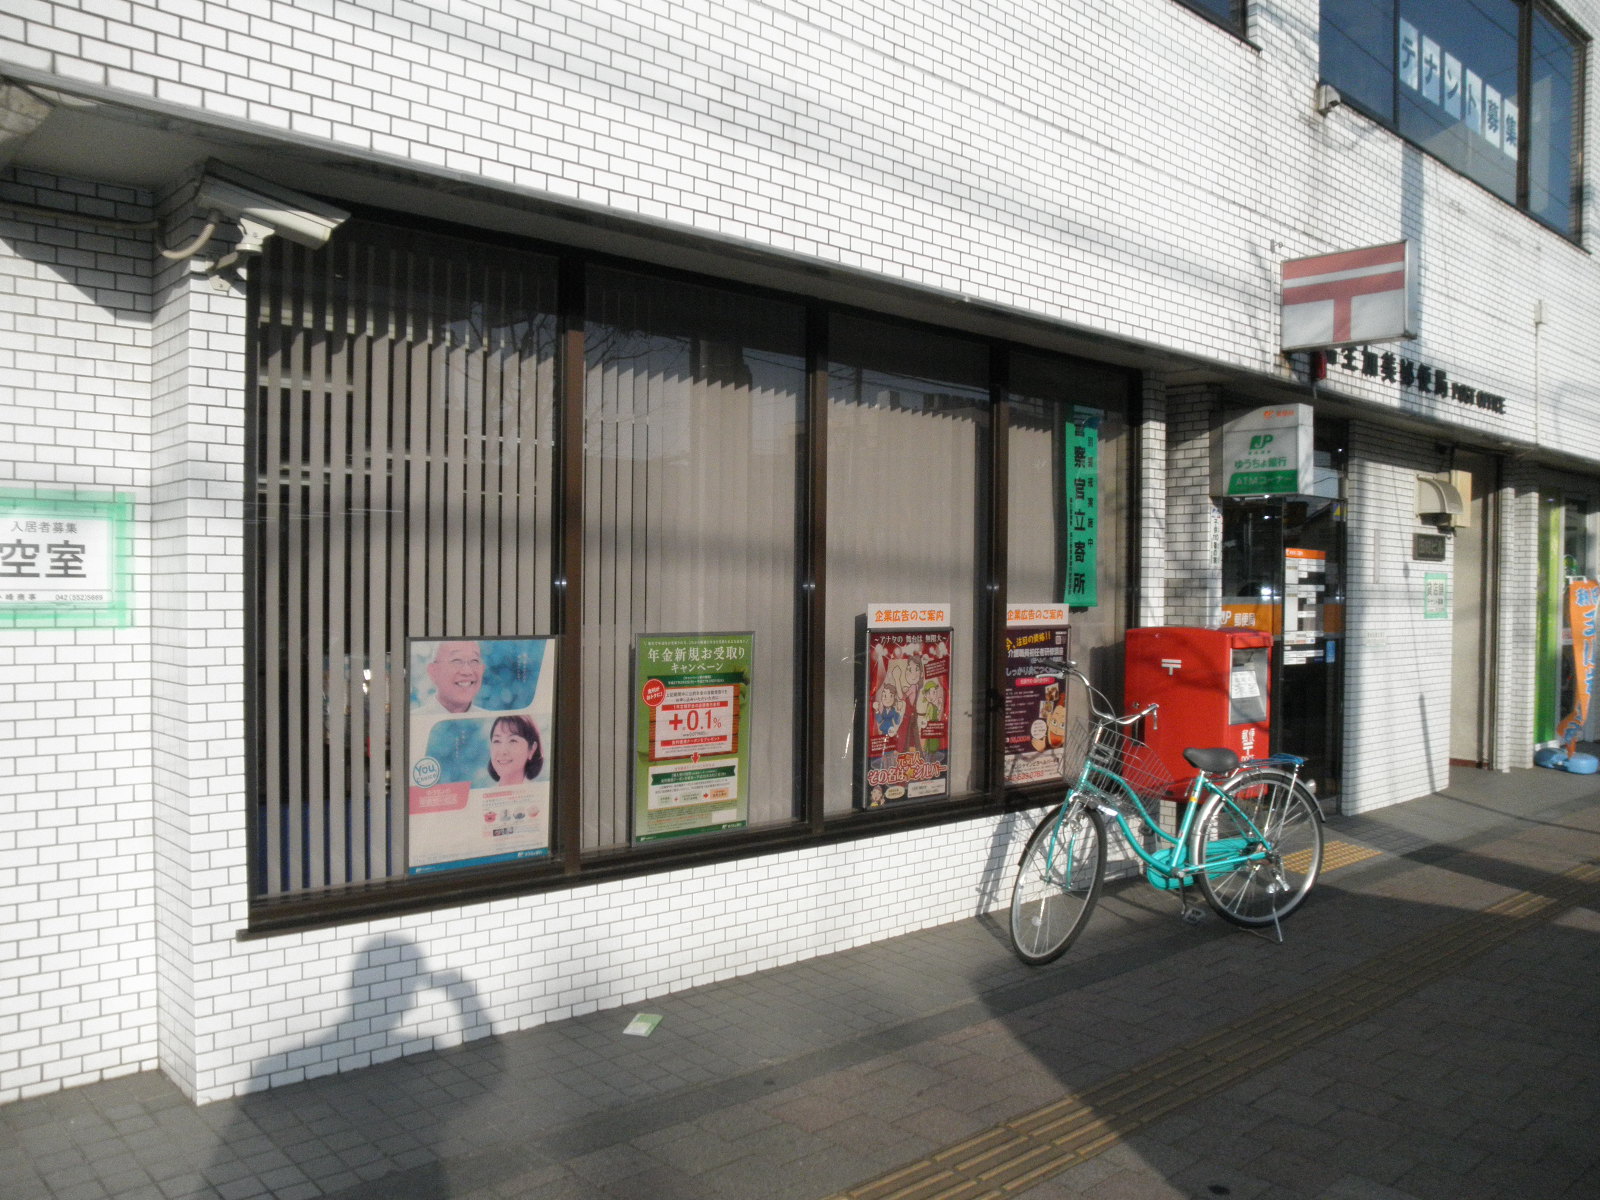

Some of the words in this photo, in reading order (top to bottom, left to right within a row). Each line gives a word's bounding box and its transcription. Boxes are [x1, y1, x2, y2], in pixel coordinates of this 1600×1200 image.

[1401, 35, 1518, 148] テナント募集
[1234, 456, 1288, 470] ゆうちょ銀行
[10, 520, 78, 534] 入居者募集
[0, 538, 87, 578] 空室
[874, 609, 945, 623] 企業広告のご案内
[1007, 609, 1064, 622] 企業広告のご案内
[647, 646, 746, 663] 年金新規お受取り
[671, 662, 724, 674] キャンペーン
